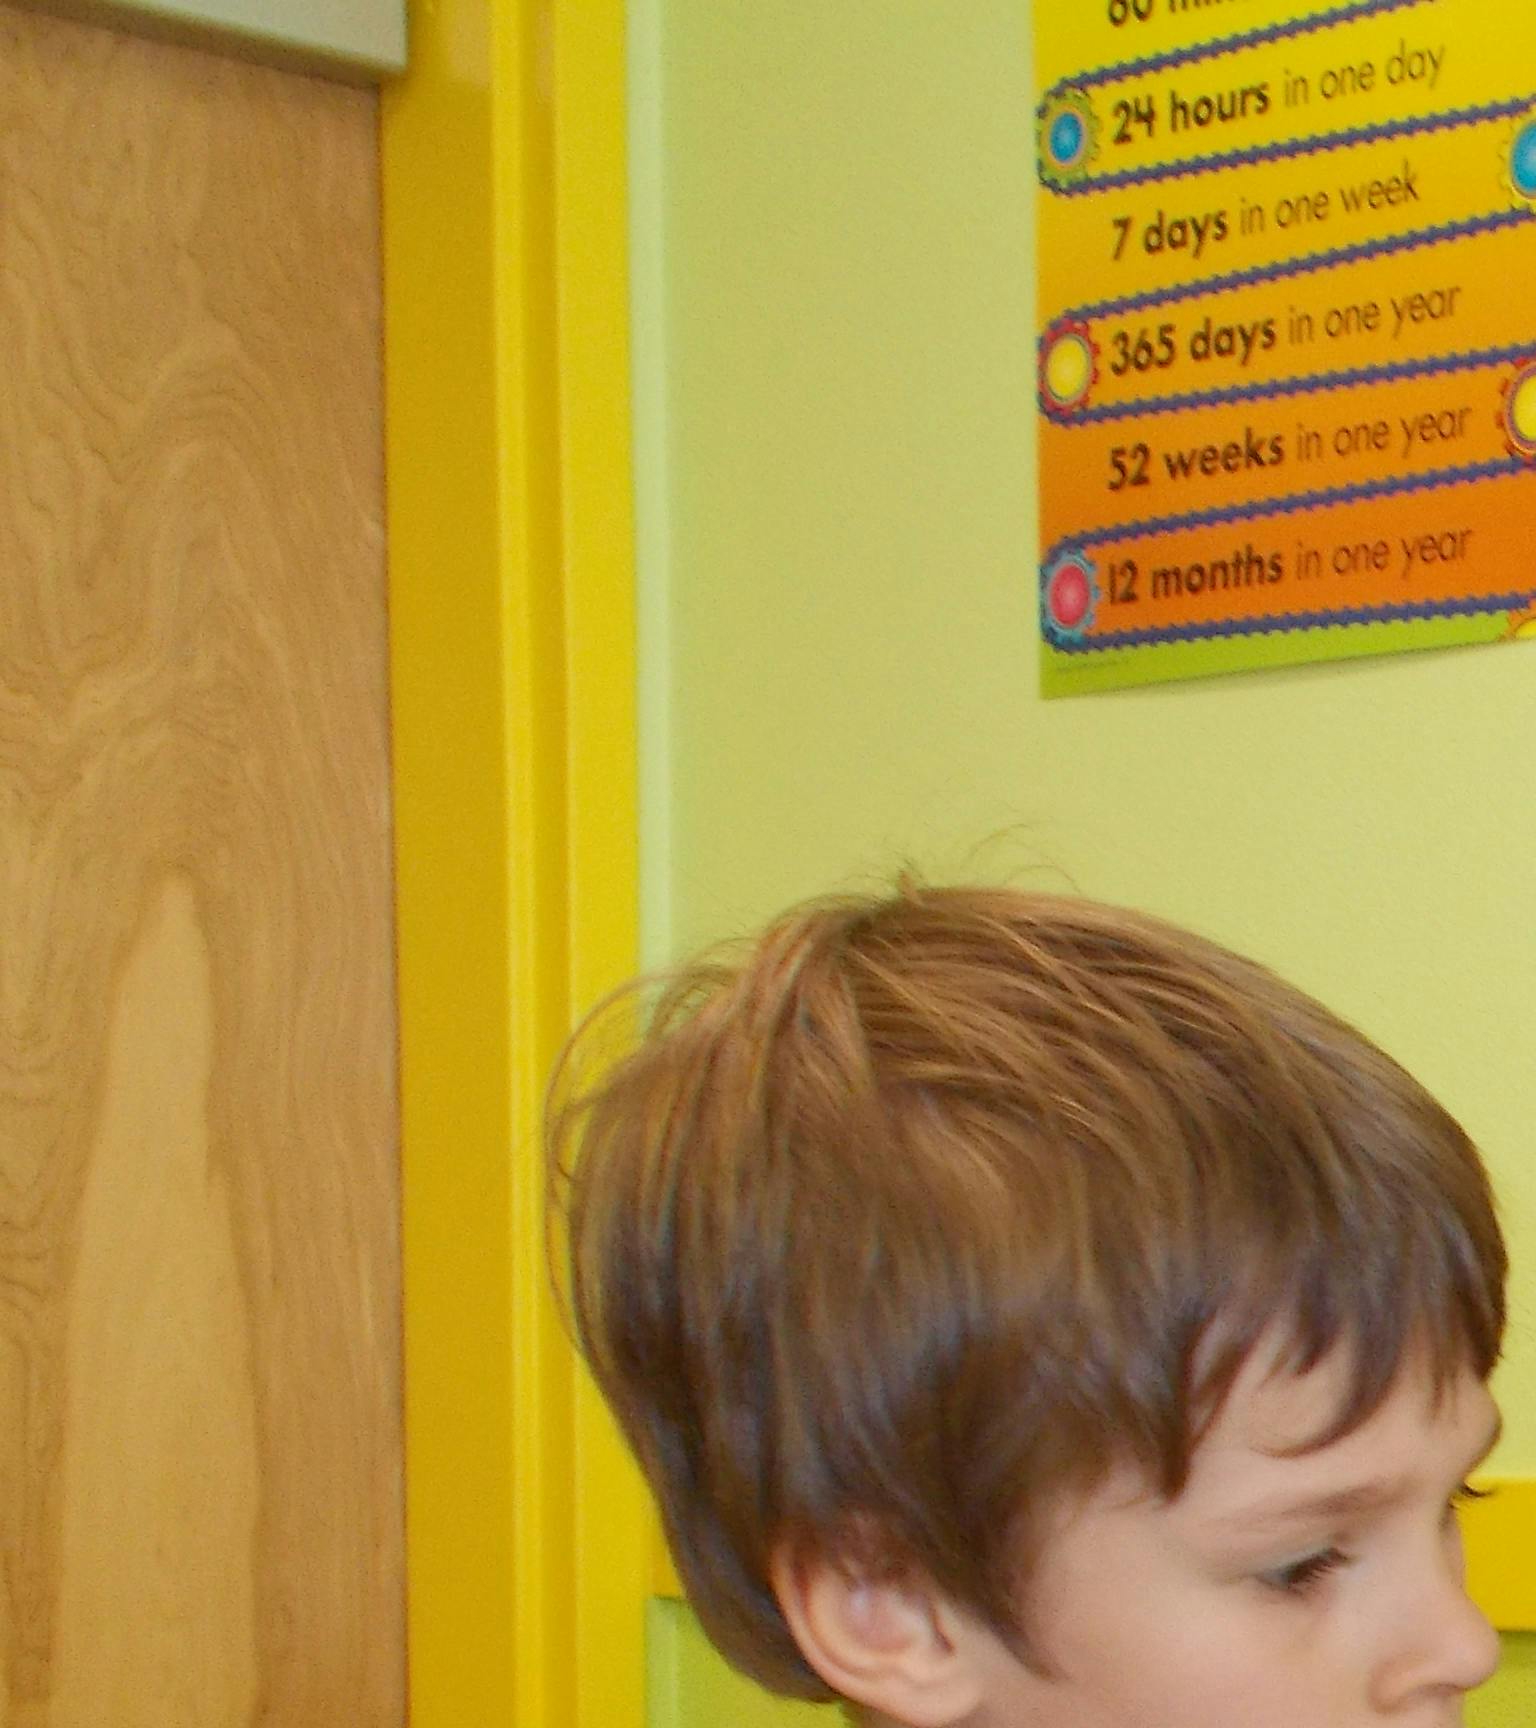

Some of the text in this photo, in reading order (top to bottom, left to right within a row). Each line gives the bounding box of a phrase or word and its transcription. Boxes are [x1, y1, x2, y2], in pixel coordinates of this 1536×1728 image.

[1113, 38, 1446, 145] 24 hours in one day
[1112, 159, 1420, 261] 7 days in one week
[1110, 285, 1462, 376] 365 days in one year
[1107, 405, 1473, 492] 52 weeks in one year
[1108, 525, 1473, 605] 12 months in one year
